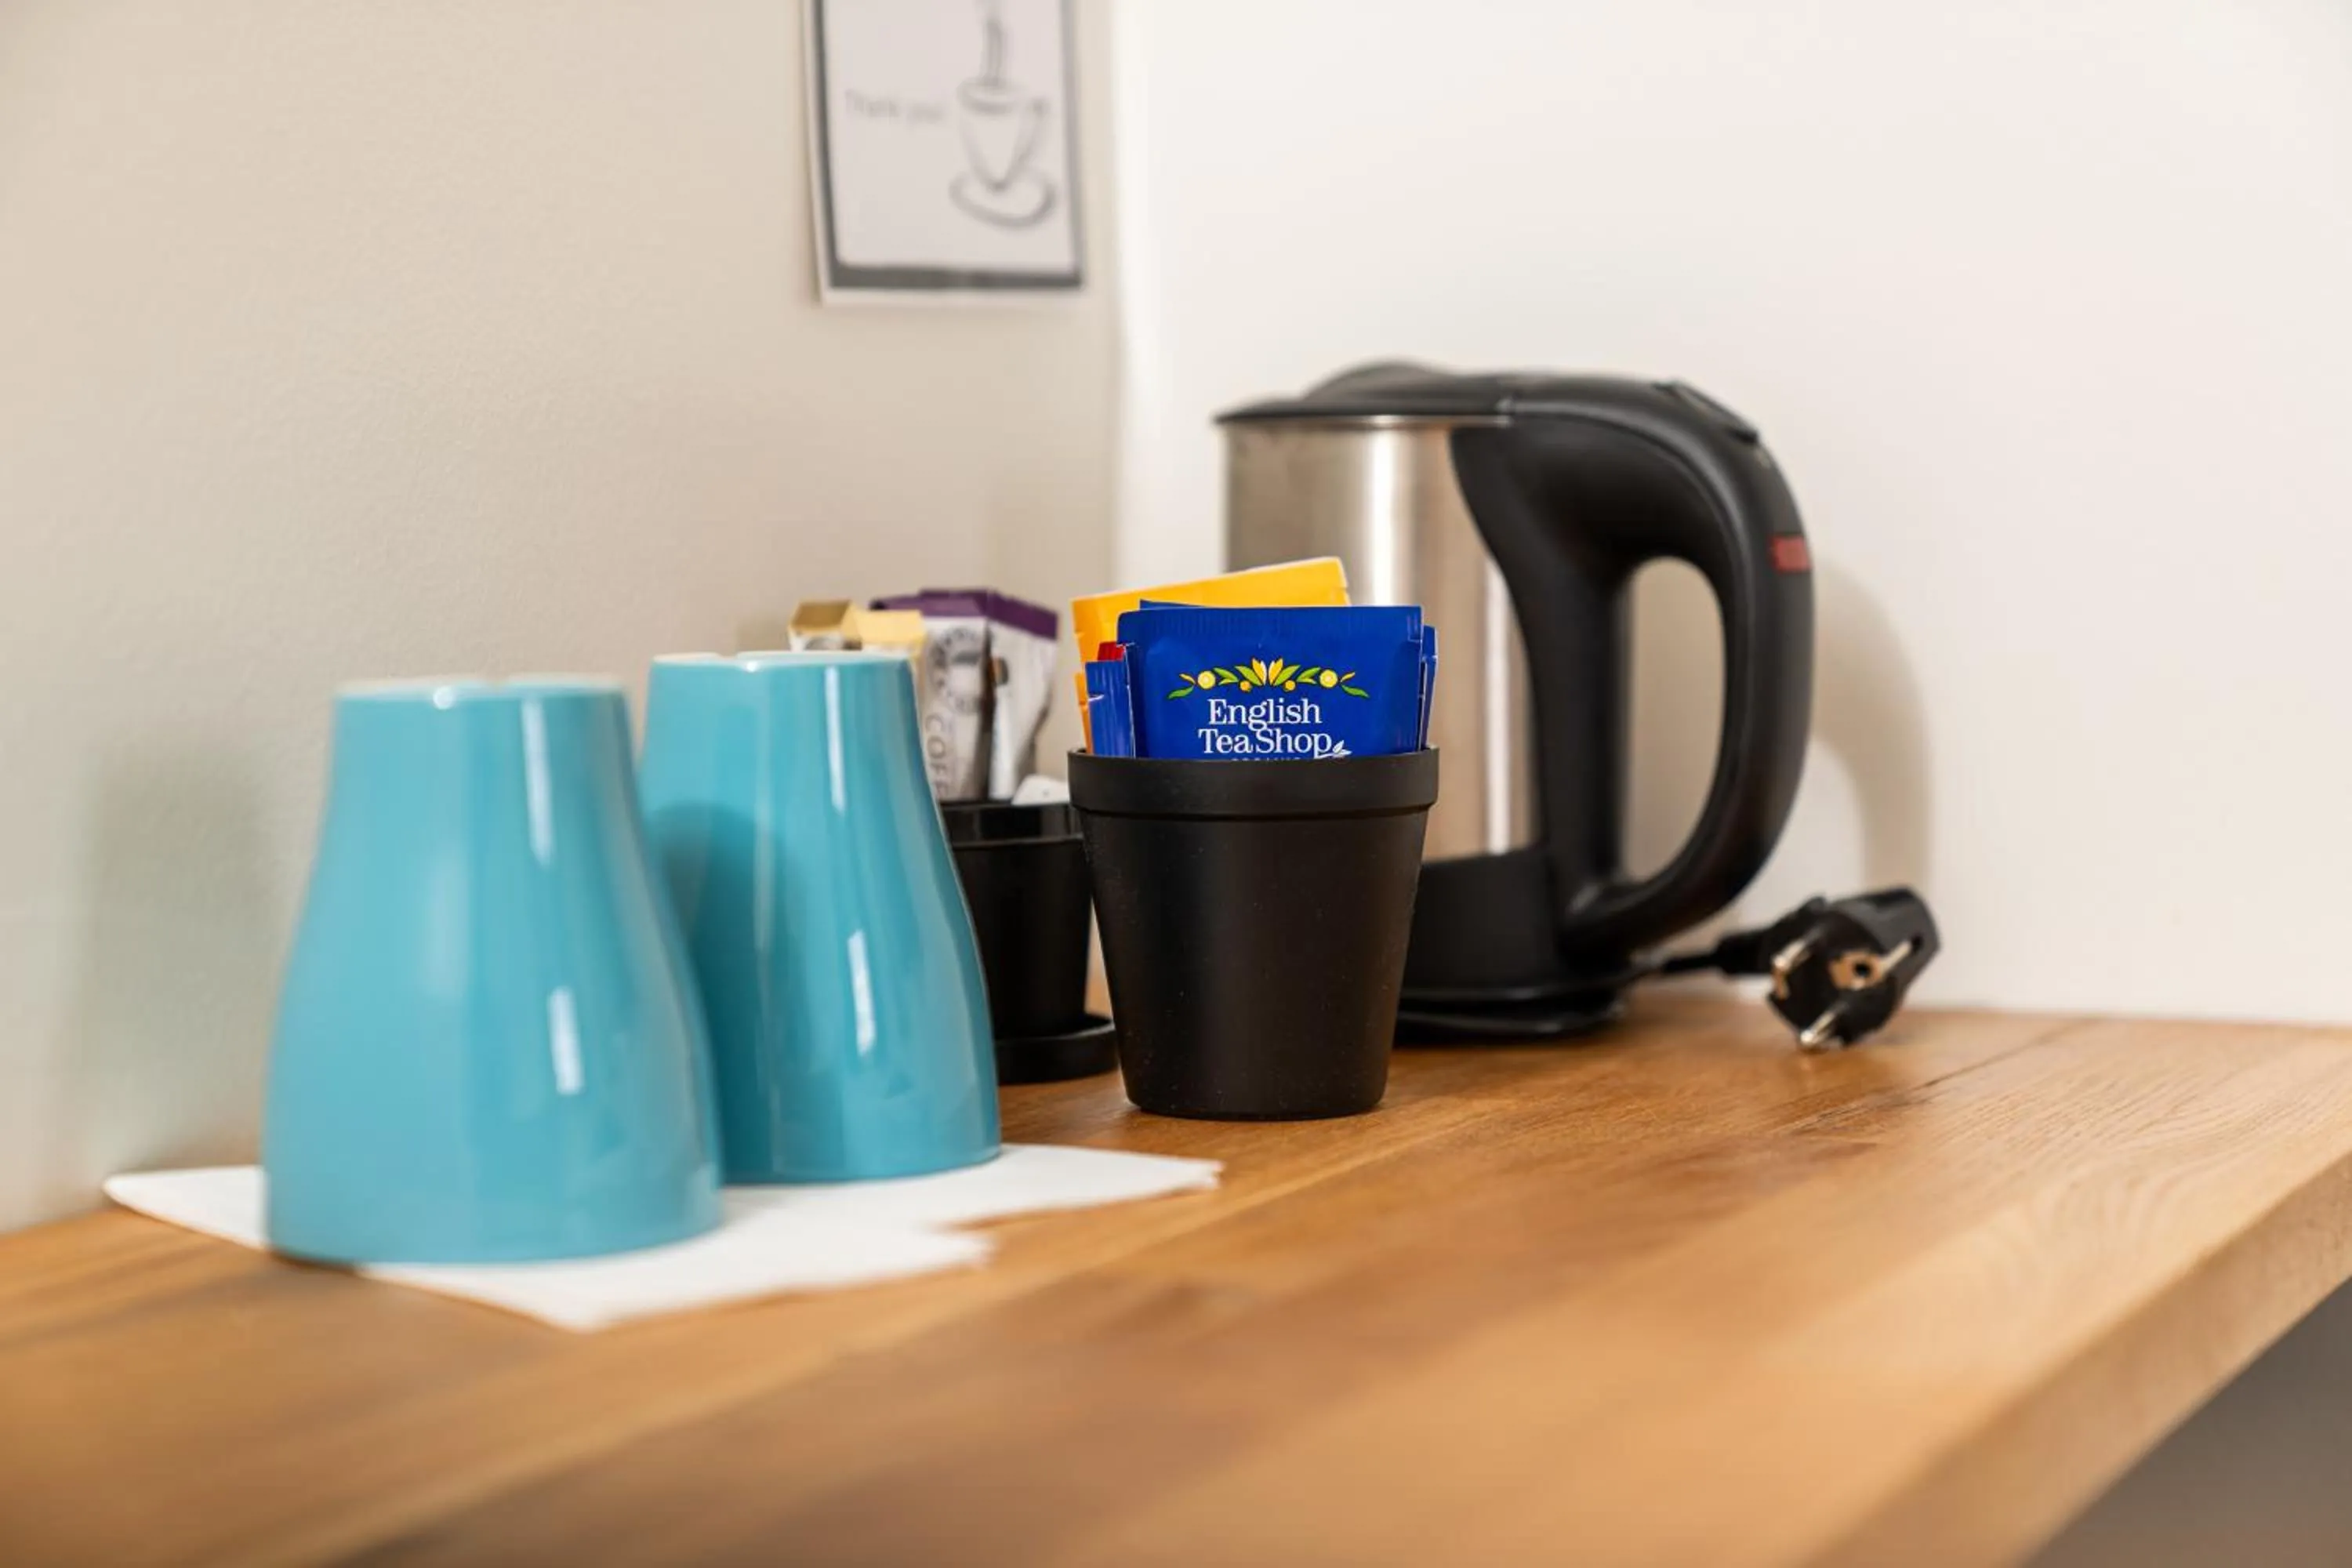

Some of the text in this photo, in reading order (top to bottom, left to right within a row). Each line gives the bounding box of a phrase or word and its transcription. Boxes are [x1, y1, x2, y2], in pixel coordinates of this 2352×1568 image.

[1207, 698, 1323, 731] English
[1198, 728, 1332, 760] Tea Shop
